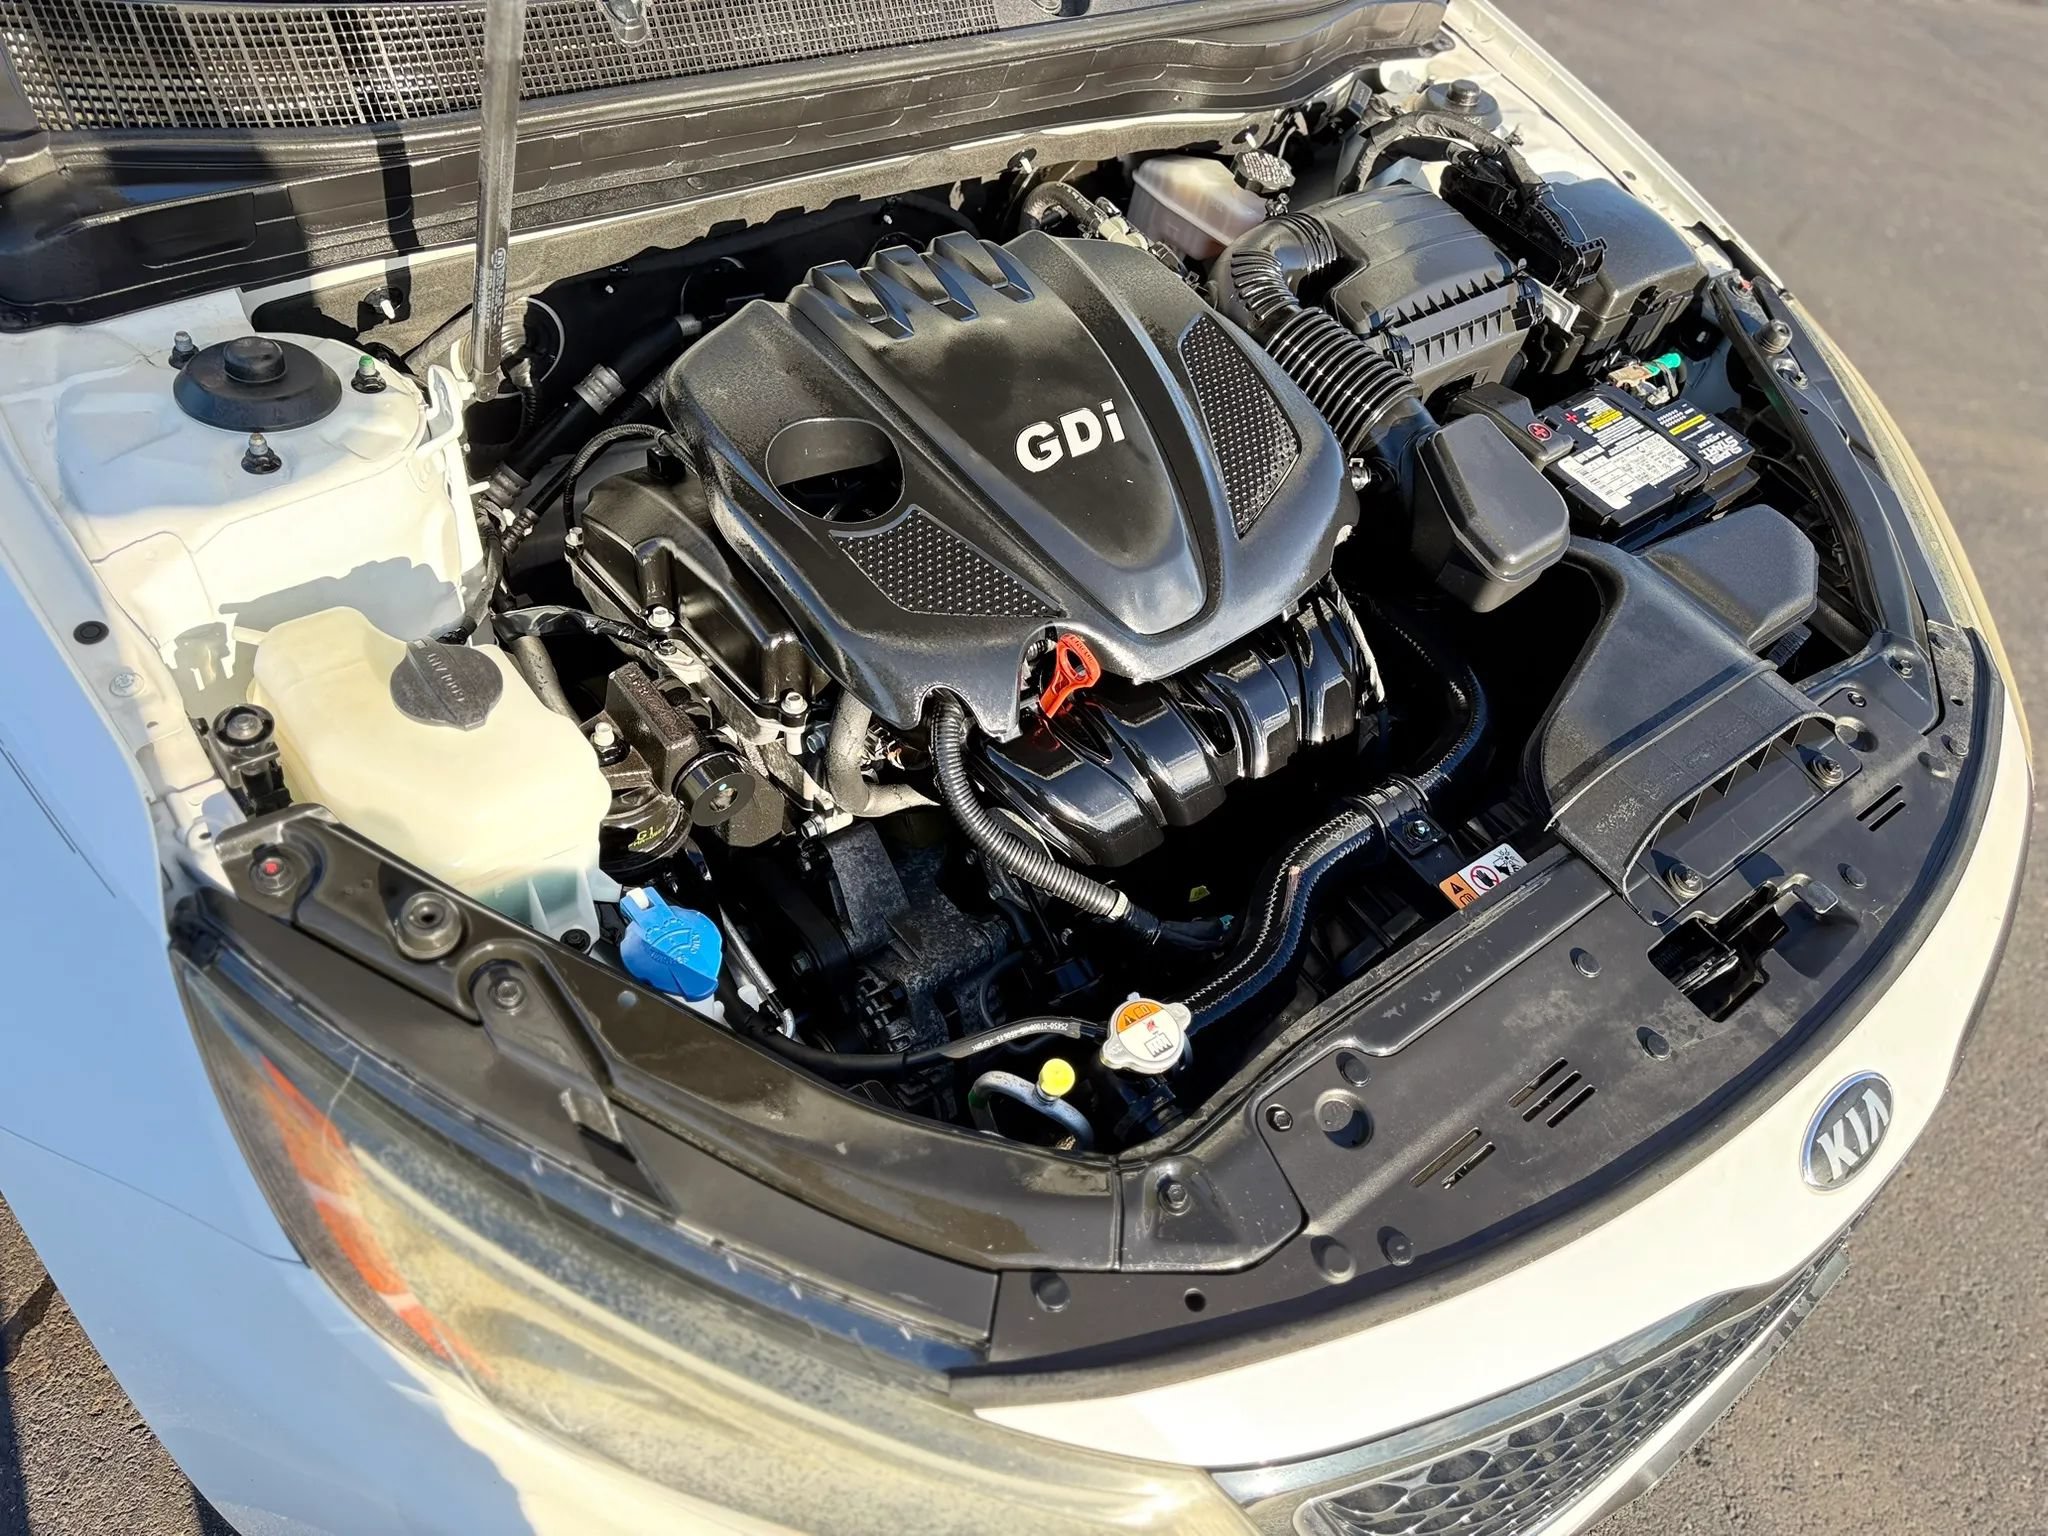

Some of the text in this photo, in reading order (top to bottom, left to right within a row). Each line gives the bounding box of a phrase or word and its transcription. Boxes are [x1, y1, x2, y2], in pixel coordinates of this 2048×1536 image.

[1015, 399, 1125, 473] GDi
[1699, 435, 1739, 460] START
[1709, 446, 1743, 465] SUPER
[1816, 1088, 1890, 1180] KIA
